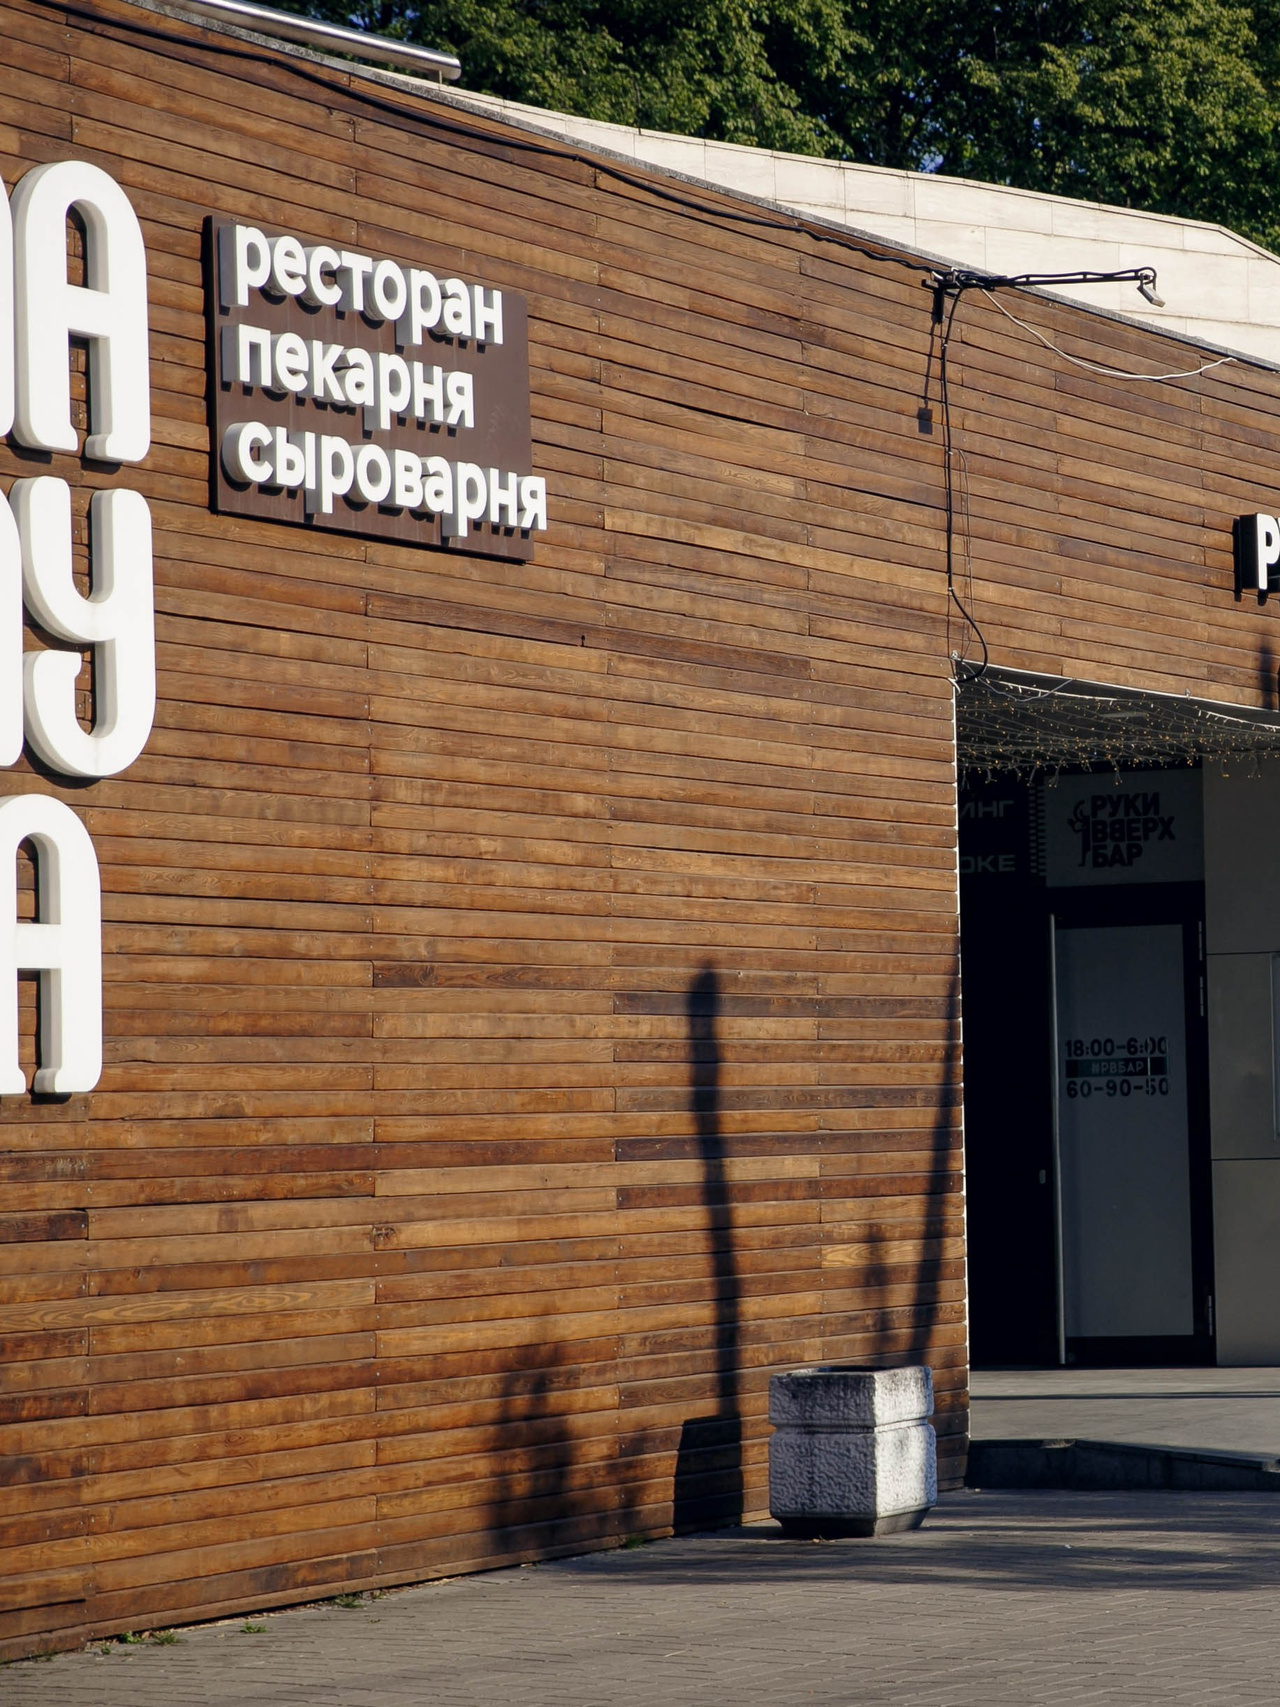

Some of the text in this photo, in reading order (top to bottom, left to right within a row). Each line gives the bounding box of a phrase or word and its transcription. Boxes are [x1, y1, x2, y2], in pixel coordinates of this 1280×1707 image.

[221, 224, 503, 346] ресторан
[0, 161, 150, 462] А
[224, 323, 475, 431] пекарня
[224, 421, 547, 537] сыроварня
[959, 799, 1016, 819] ИНГ
[1091, 792, 1160, 818] РУКИ
[1092, 816, 1176, 843] ВВЕРХ
[959, 854, 1017, 874] ОКЕ
[1092, 843, 1144, 868] БАР
